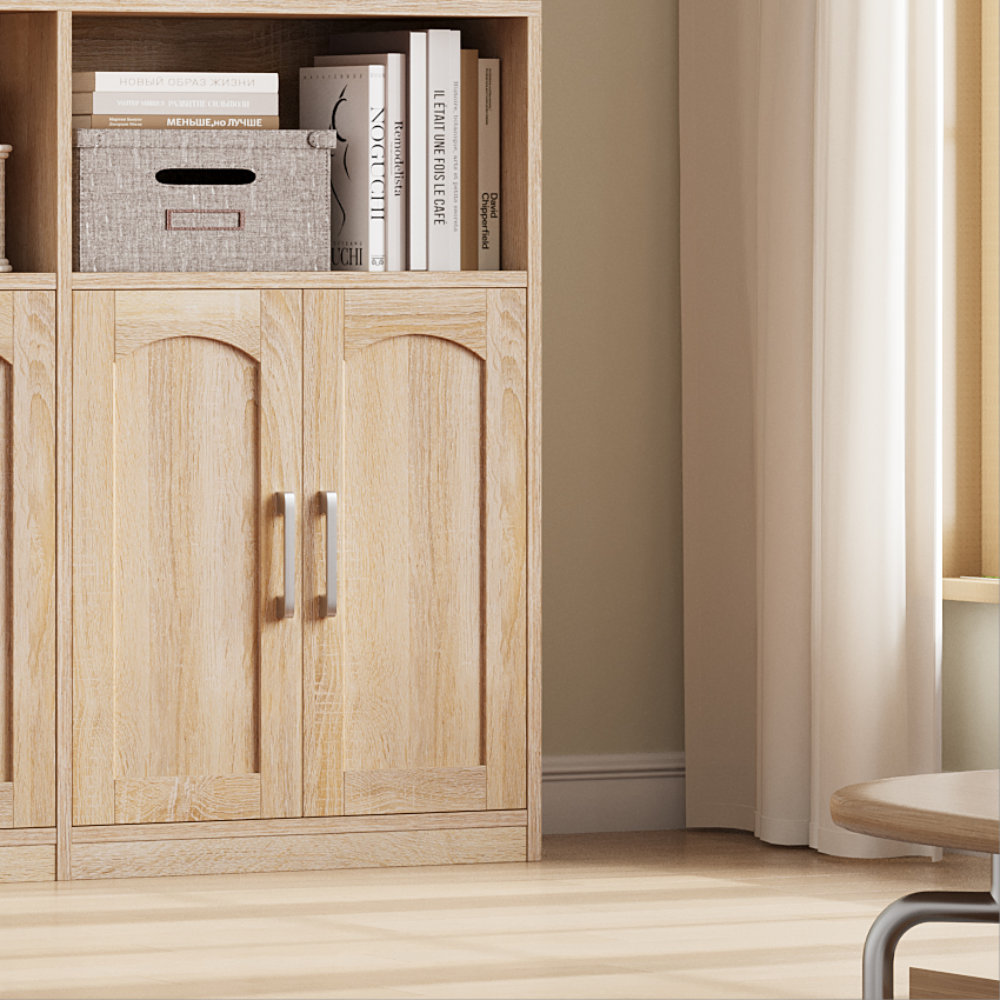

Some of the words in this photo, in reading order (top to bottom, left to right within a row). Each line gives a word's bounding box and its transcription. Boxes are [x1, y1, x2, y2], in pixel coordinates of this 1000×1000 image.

[119, 76, 165, 87] НОВЫЙ
[167, 78, 207, 87] ОБРАЗ
[209, 78, 256, 88] ЖИЗНИ
[434, 90, 445, 99] IL
[227, 118, 263, 127] ЛУЧШЕ
[434, 103, 447, 131] ÉTAIT
[434, 134, 445, 155] UNE
[370, 107, 385, 220] NOGUCHI
[393, 121, 404, 196] Remodelista
[434, 158, 445, 181] FOIS
[434, 184, 445, 196] LE
[434, 199, 447, 226] CAFÉ
[490, 192, 499, 218] David
[480, 192, 490, 250] Chipperfield
[331, 247, 363, 266] UCHI
